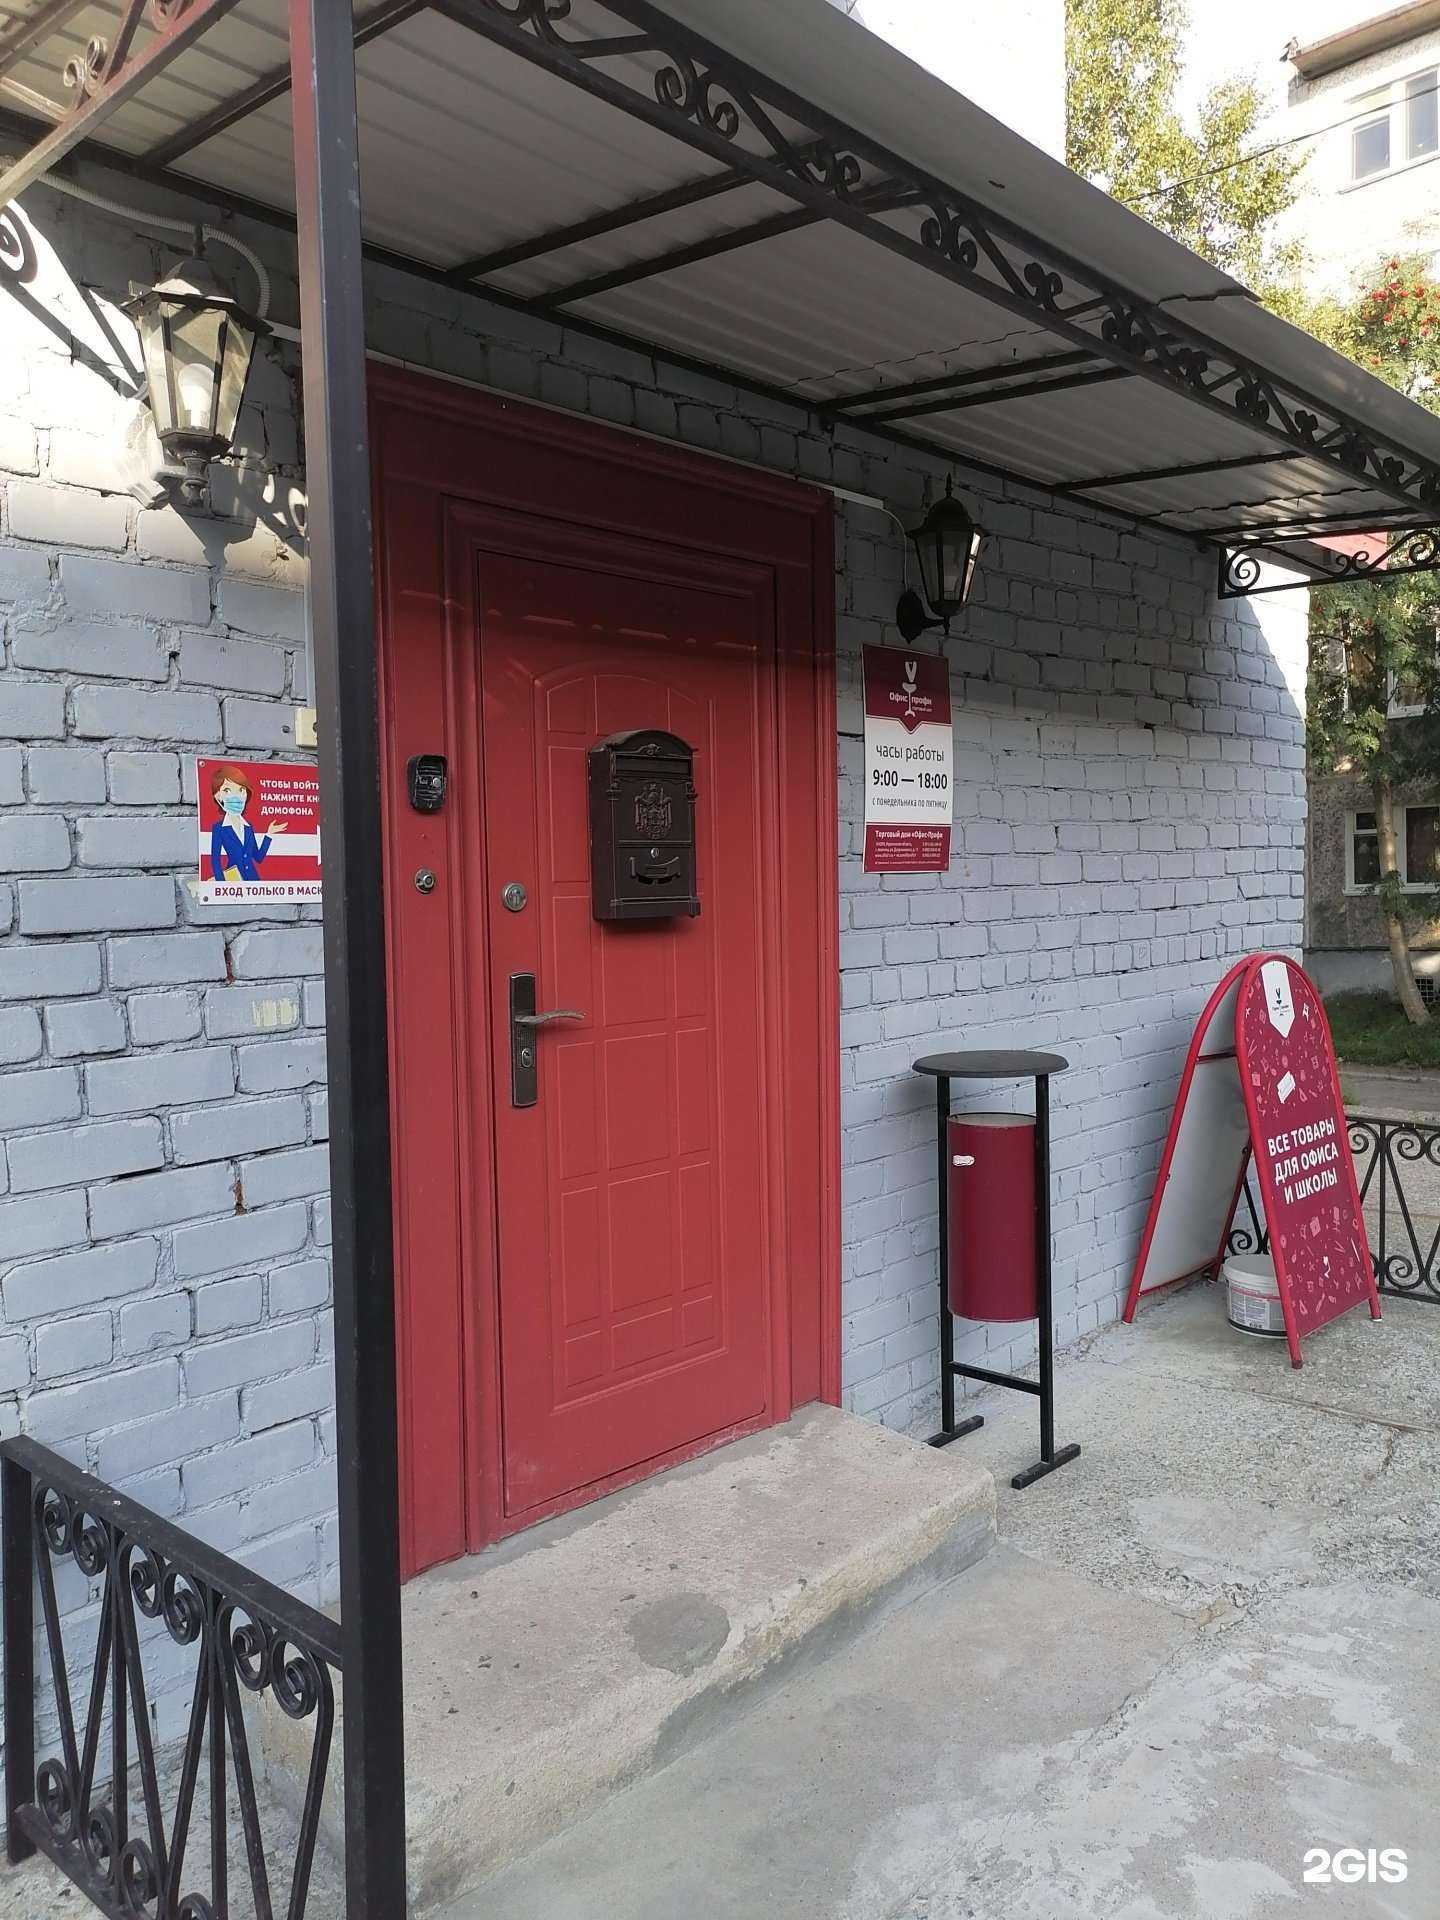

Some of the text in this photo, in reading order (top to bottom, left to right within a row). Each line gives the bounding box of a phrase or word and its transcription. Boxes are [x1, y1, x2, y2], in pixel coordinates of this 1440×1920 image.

[889, 692, 908, 703] Офис
[876, 744, 945, 762] часы работы
[259, 779, 291, 790] ЧТОБЫ
[260, 793, 320, 804] НАЖМИТЕ КН
[876, 797, 917, 808] понедельника
[918, 799, 925, 808] по
[926, 799, 948, 811] пятницу
[260, 806, 314, 816] ДОМОФОНА
[875, 830, 900, 839] Торговый
[214, 886, 322, 898] ВХОД ТОЛЬКО В МАСК
[1267, 1117, 1336, 1157] ВСЕ ТОВАРЫ
[1275, 1142, 1339, 1186] ДЛЯ ОФИСА
[1284, 1167, 1338, 1205] И ШКОЛЫ
